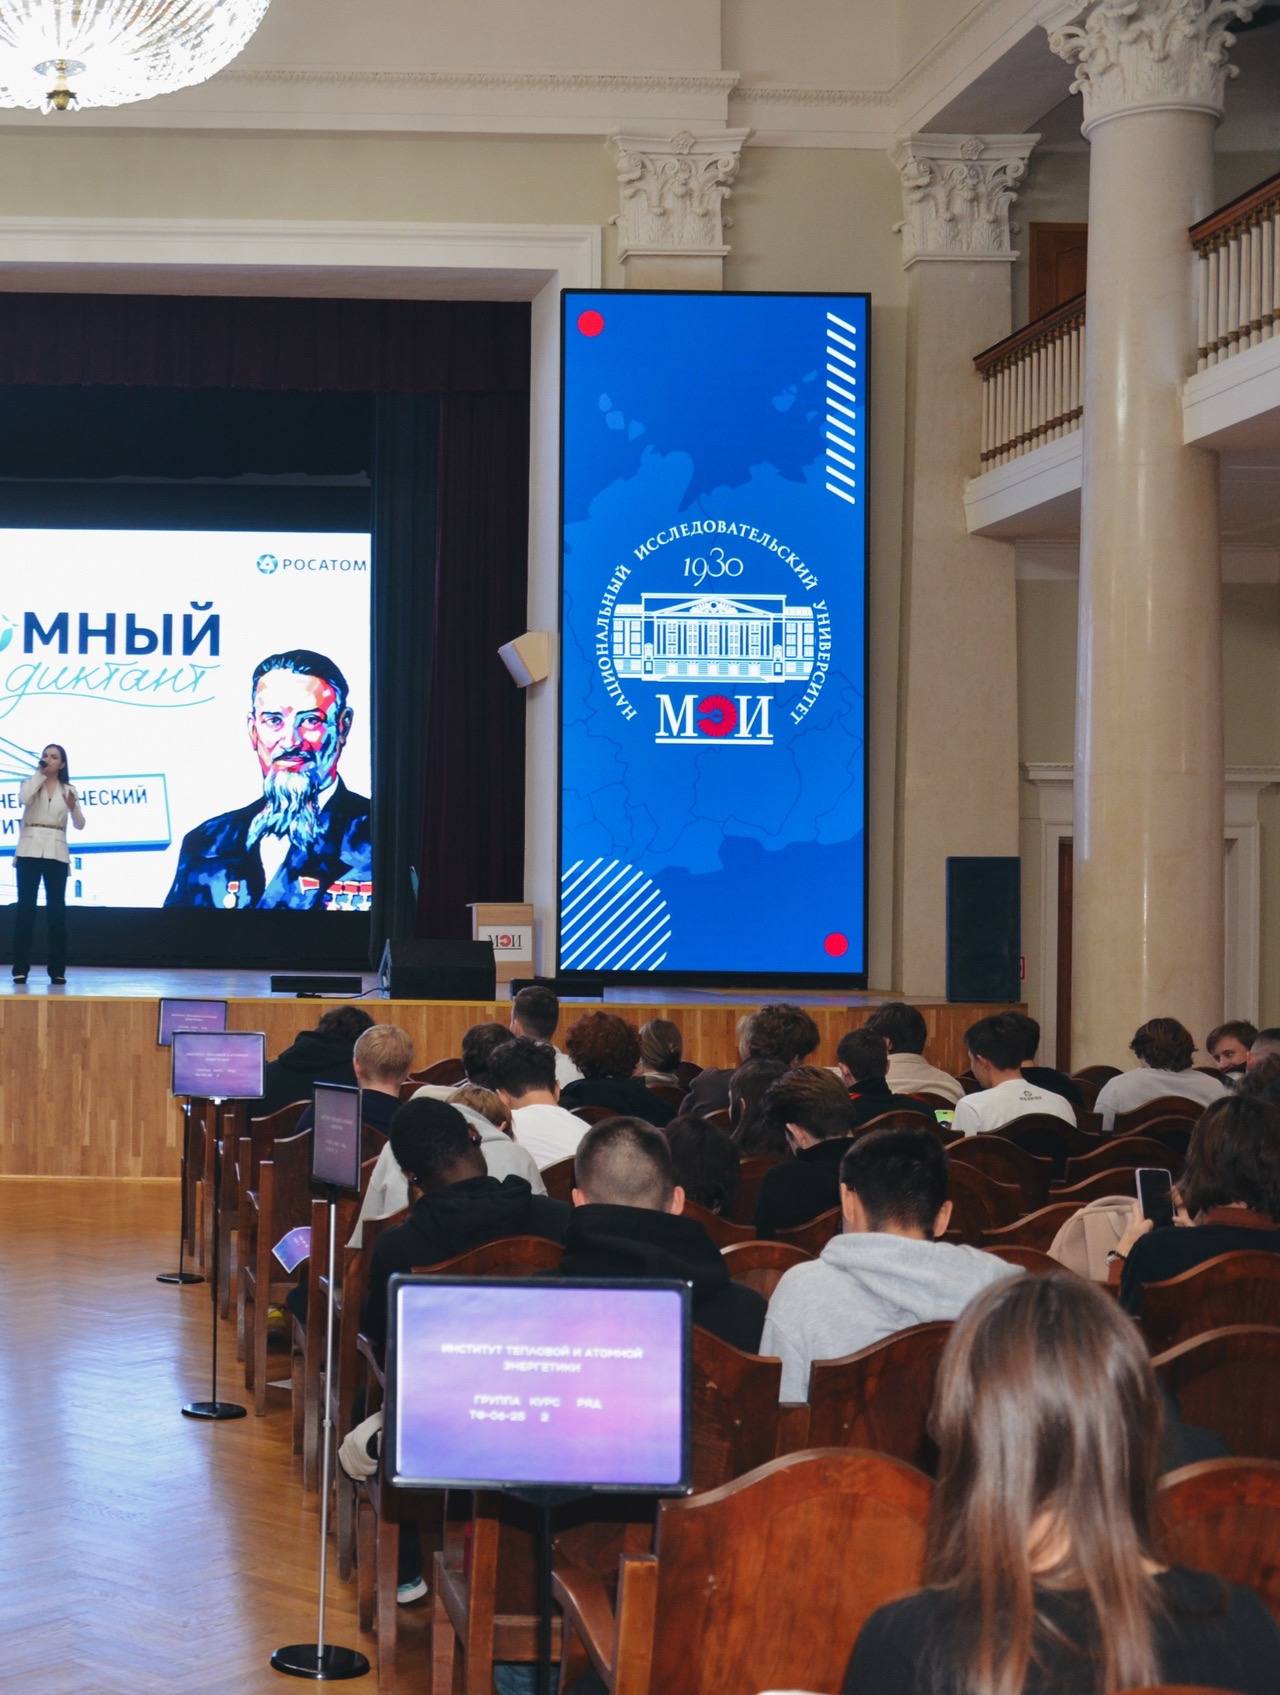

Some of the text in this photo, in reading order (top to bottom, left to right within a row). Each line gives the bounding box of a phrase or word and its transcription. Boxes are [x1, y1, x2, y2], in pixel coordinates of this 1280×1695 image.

[282, 558, 368, 571] РОСАТОМ
[684, 547, 744, 587] 1930
[595, 519, 832, 725] НАЦИОНАЛЬНЫЙ ИССЛЕДОВАТЕЛЬСКИЙ УНИВЕРСИТЕТ
[655, 694, 774, 738] МЭИ
[441, 1343, 644, 1359] ИНСТИТУТ ТЕПЛОВОЙ И АТОМНОЙ
[503, 1361, 582, 1373] ЭНЕРГЕТИКИ
[473, 1394, 603, 1410] ГРУППА КУРС РЯД
